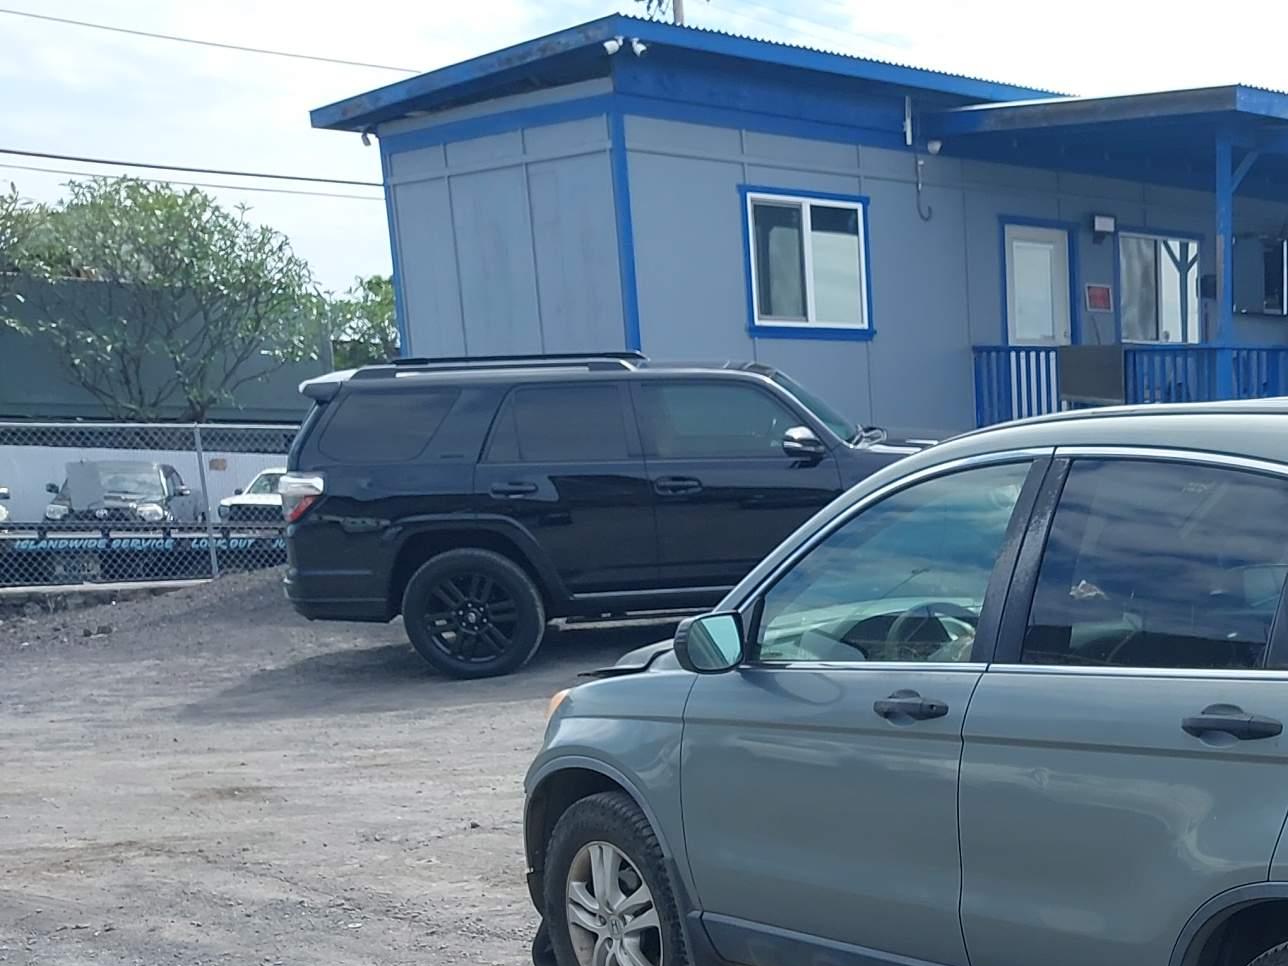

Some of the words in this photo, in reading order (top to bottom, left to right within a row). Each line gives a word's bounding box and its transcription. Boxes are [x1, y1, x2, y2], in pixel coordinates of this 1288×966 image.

[111, 538, 174, 550] SERVICE
[191, 538, 227, 550] LOK
[229, 538, 255, 549] OUT
